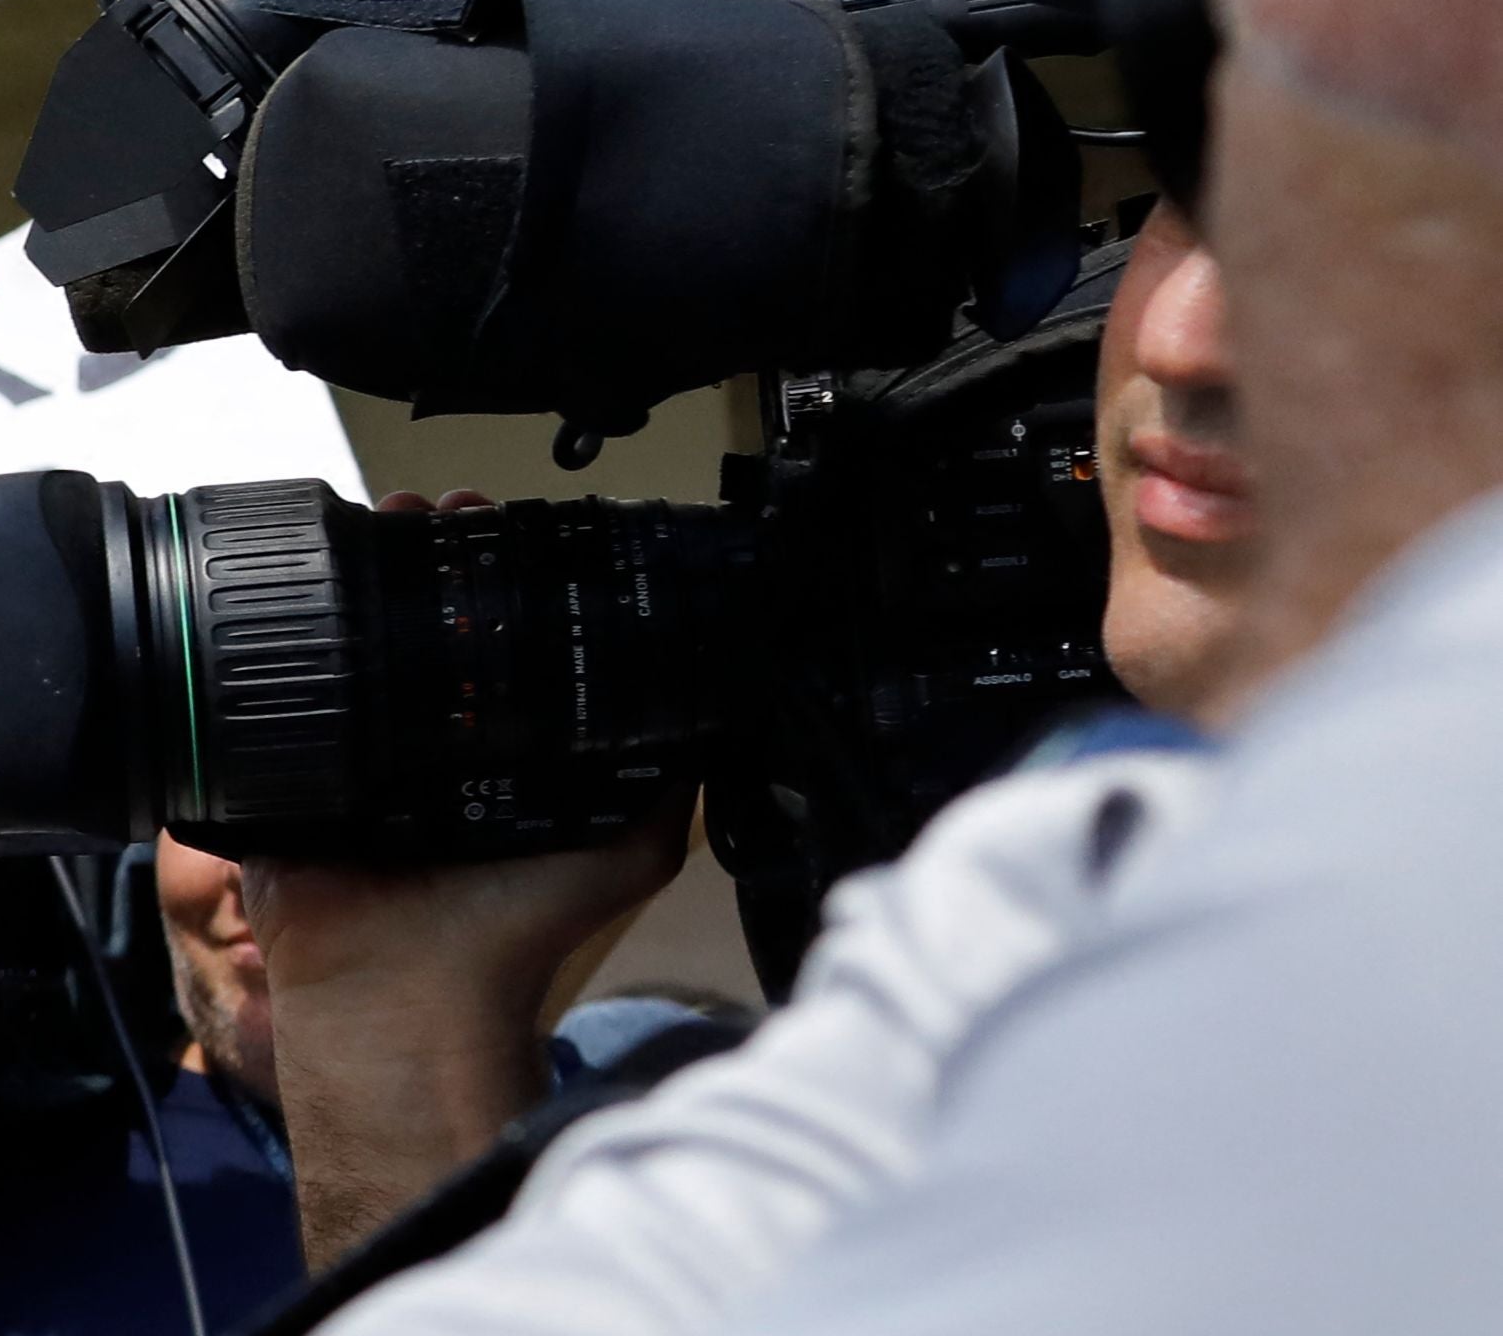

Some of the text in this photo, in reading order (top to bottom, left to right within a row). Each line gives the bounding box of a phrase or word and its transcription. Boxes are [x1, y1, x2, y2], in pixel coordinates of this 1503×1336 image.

[567, 582, 581, 616] JAPAN
[635, 572, 652, 617] CANON
[571, 625, 583, 637] IN
[572, 644, 586, 674] MADE
[1057, 669, 1092, 680] GAIN
